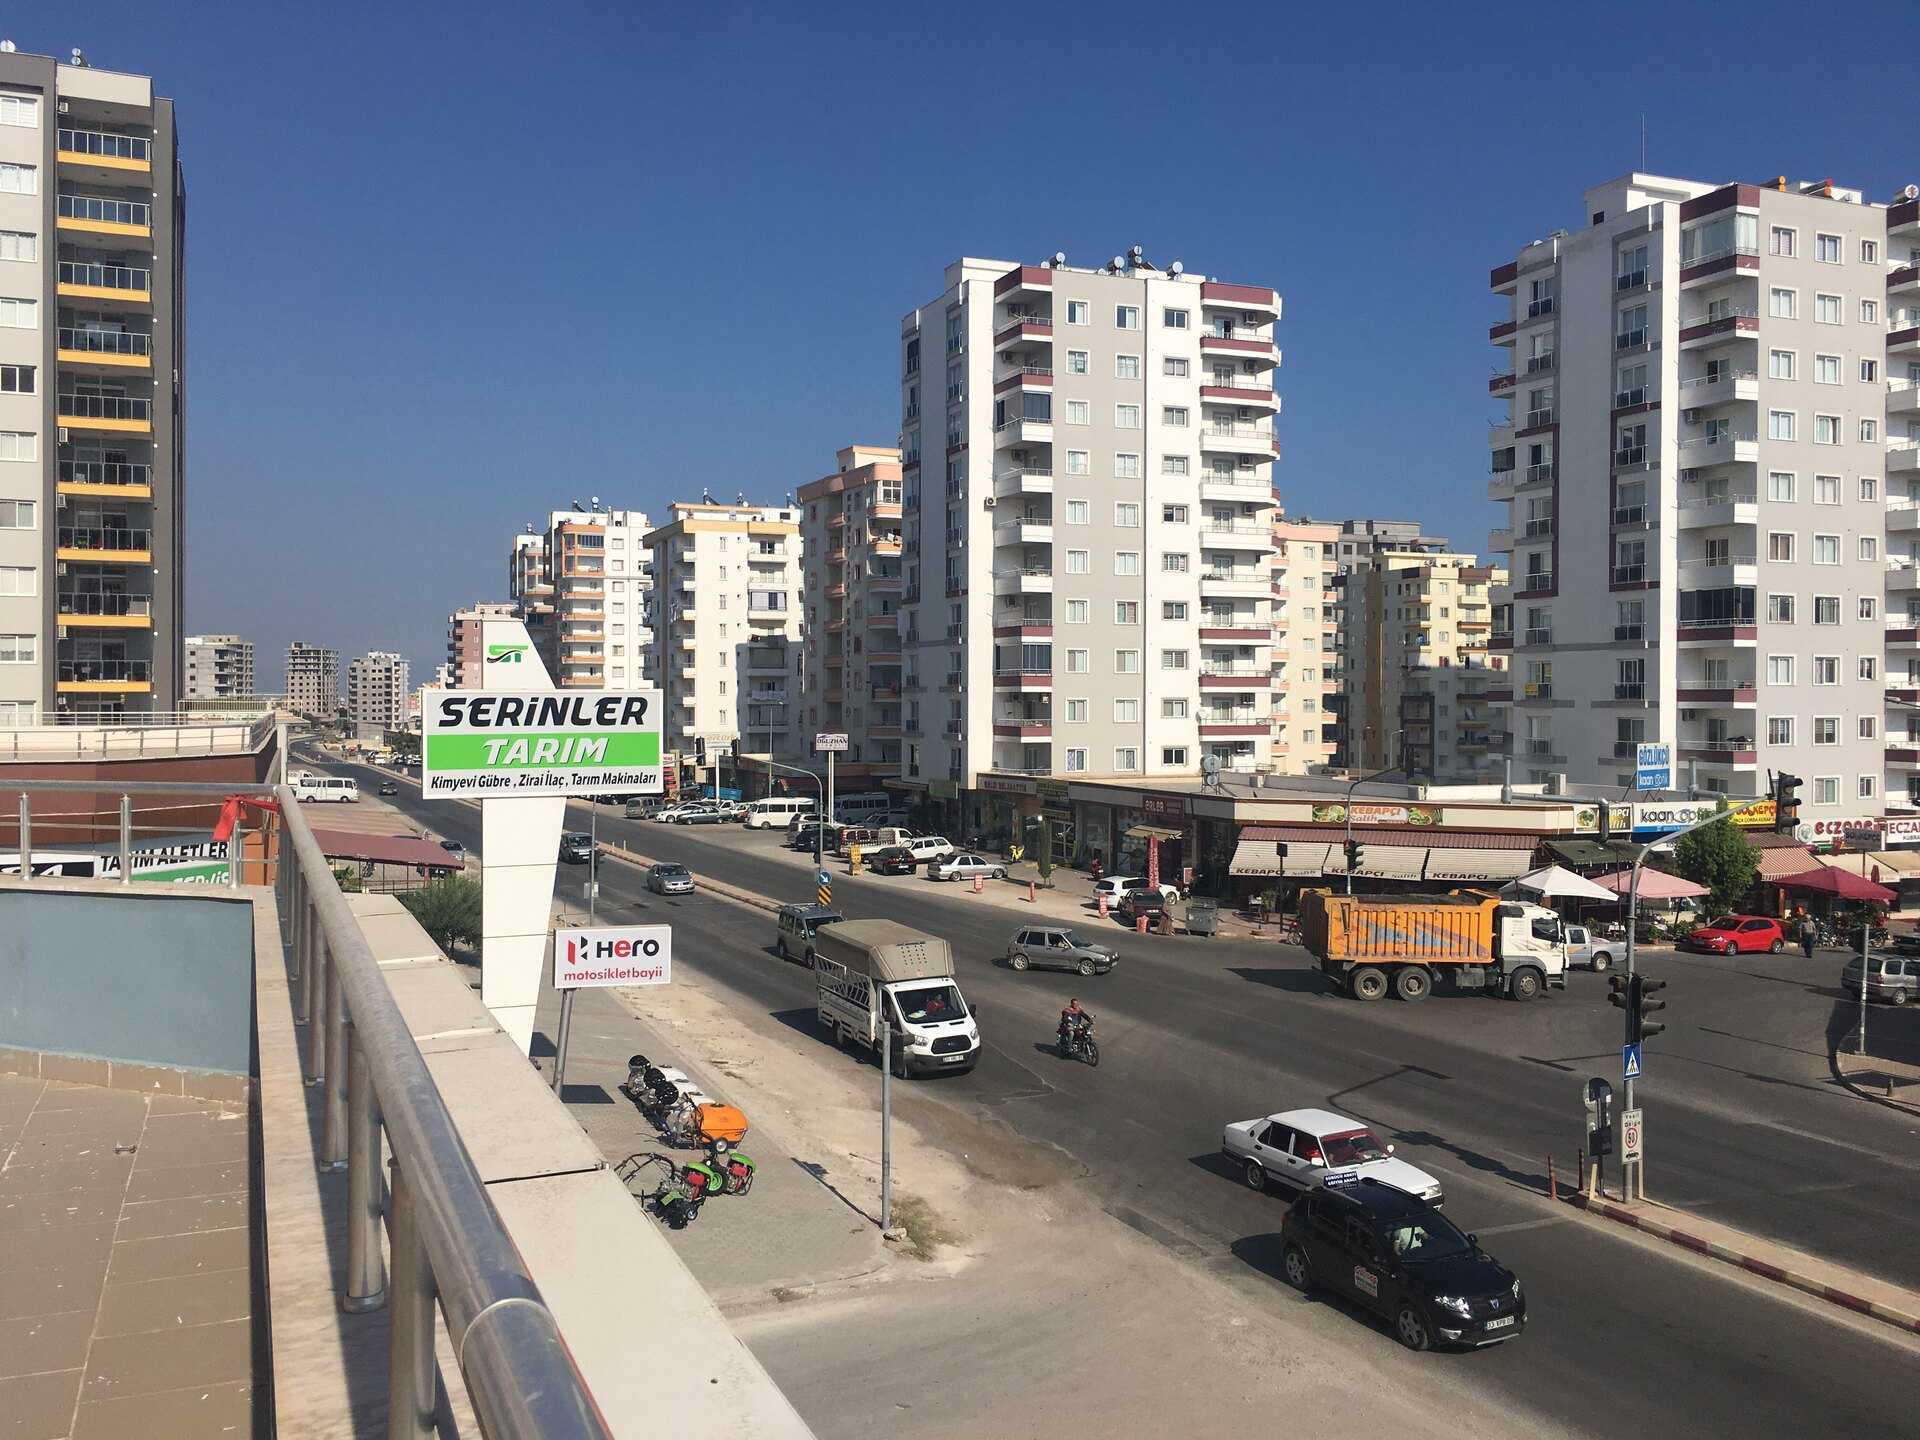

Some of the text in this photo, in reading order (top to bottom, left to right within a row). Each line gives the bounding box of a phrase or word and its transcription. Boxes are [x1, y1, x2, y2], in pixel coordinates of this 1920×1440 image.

[483, 737, 609, 765] TARIM
[431, 775, 476, 791] Kimyevi
[571, 773, 600, 786] Tarım
[601, 771, 656, 785] Makinaları
[1641, 809, 1674, 823] kaan
[1890, 822, 1920, 834] ECZA
[101, 849, 154, 872] TAIM
[1628, 1132, 1635, 1143] 50
